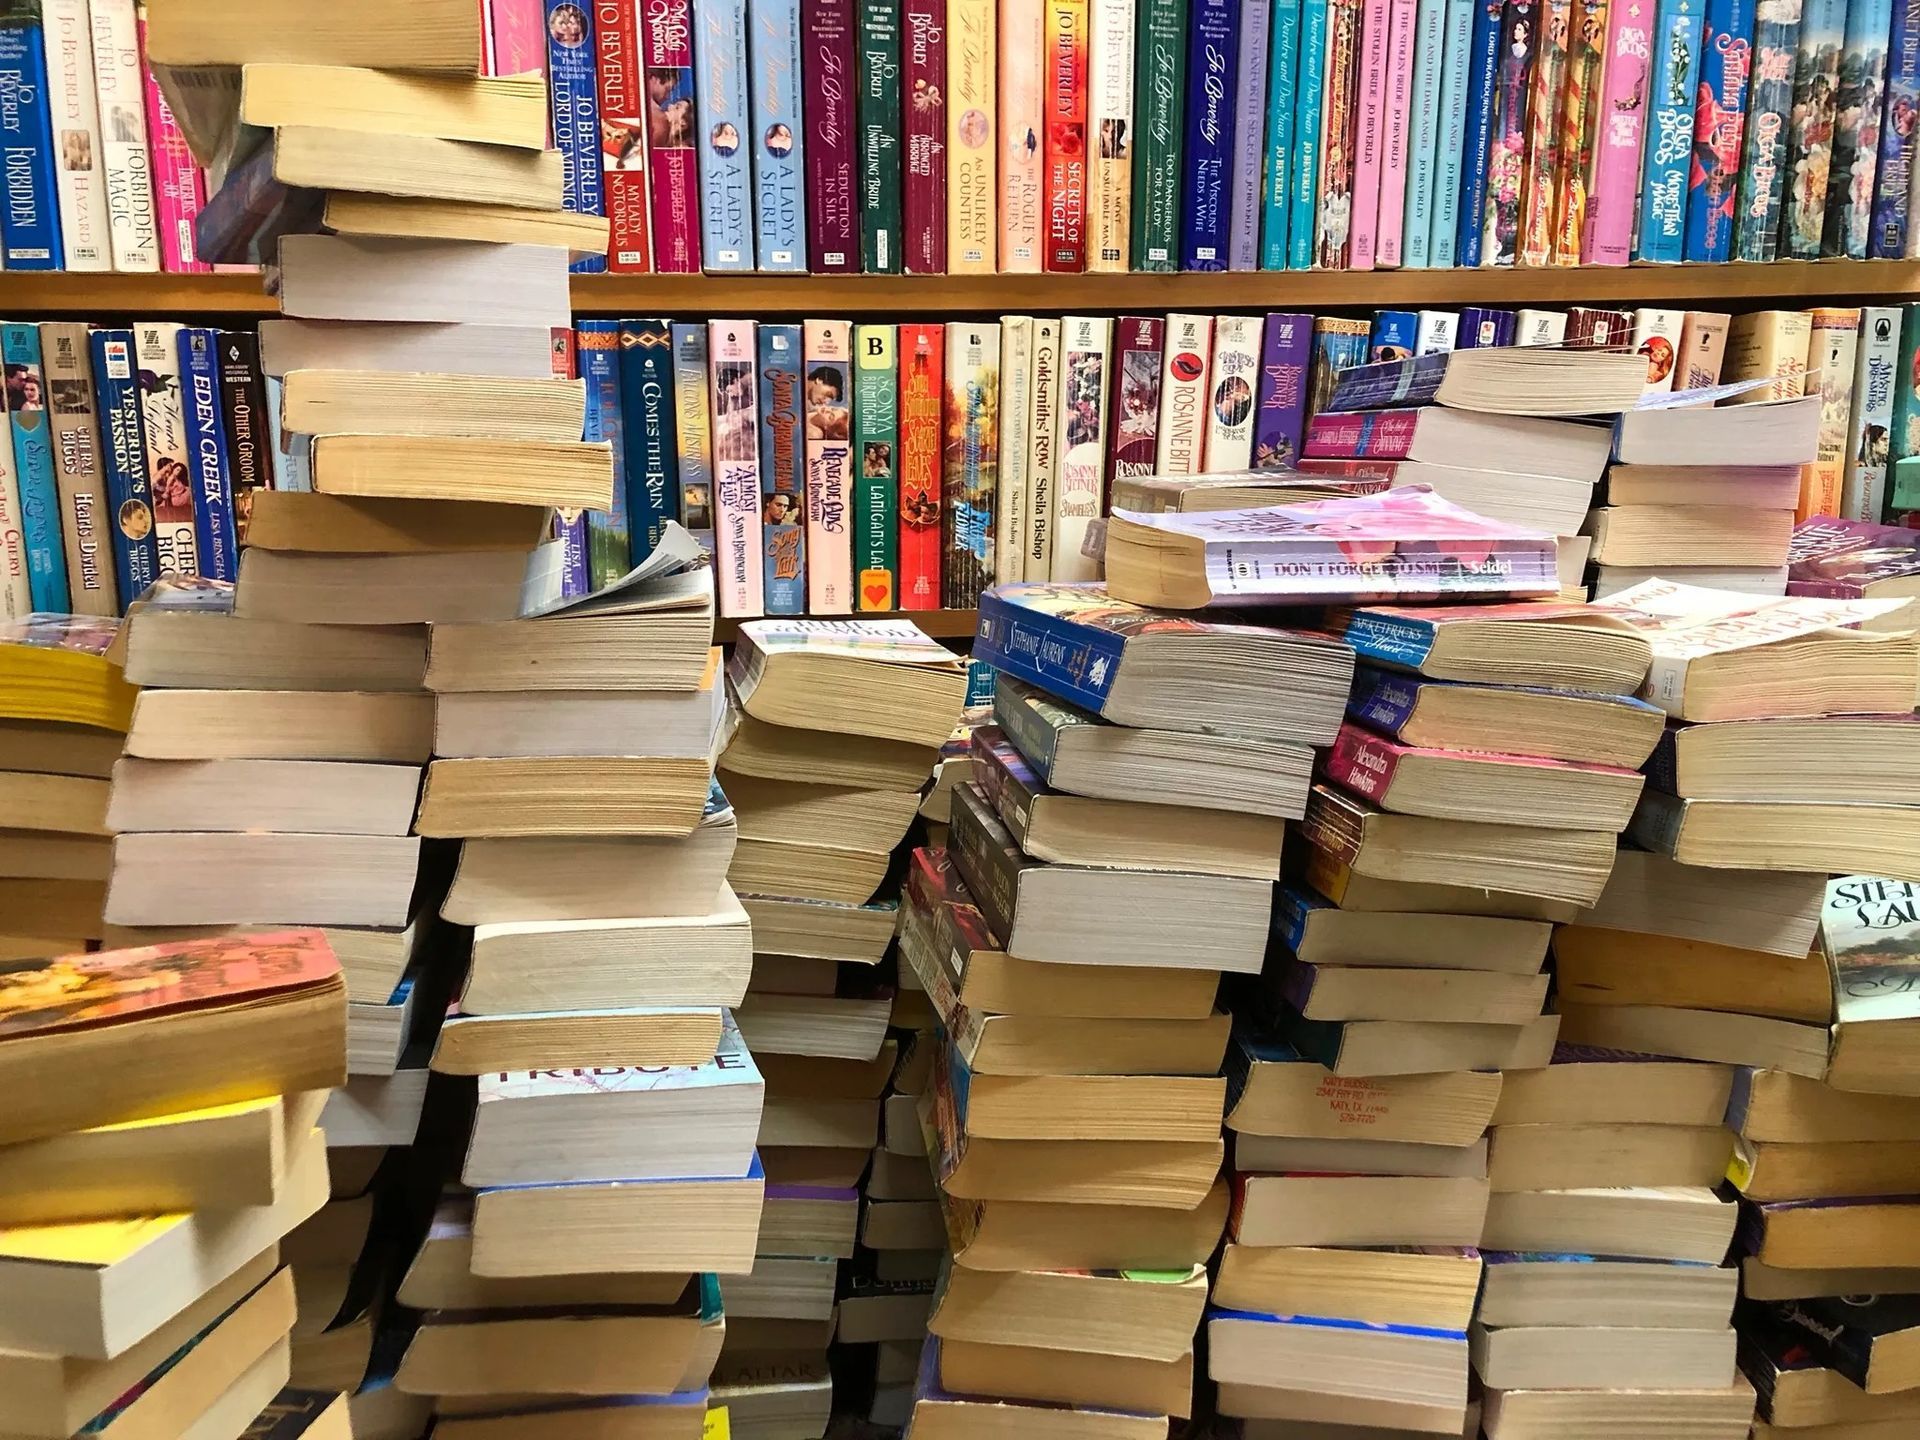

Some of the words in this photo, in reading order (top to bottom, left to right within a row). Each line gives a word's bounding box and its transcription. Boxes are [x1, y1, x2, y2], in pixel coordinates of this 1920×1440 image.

[598, 3, 618, 23] JO
[1056, 8, 1073, 28] JO
[1373, 5, 1383, 25] THE
[1458, 13, 1467, 43] EMILY
[1903, 0, 1919, 35] ANET
[94, 15, 117, 94] BEVERLEY
[119, 48, 136, 67] JO
[820, 46, 841, 73] Jo
[908, 13, 932, 68] BEVERLEY
[1155, 45, 1174, 74] Jo
[1206, 45, 1225, 74] Jo
[1281, 16, 1296, 61] Deirdre
[1371, 29, 1381, 64] STOLEN
[1457, 48, 1465, 68] AND
[1488, 31, 1496, 55] LORD
[62, 40, 81, 121] BEVERLEY
[601, 31, 624, 113] BEVERLEY
[866, 51, 886, 100] BEVERLEY
[883, 63, 897, 78] JO
[1059, 34, 1072, 117] BEVERLEY
[1107, 29, 1123, 114] BEVERLEY
[1279, 61, 1296, 82] and
[1455, 71, 1464, 91] THE
[1901, 37, 1917, 85] BIEBER
[0, 69, 21, 133] BEVERLEY
[18, 84, 35, 102] JO
[1279, 88, 1292, 107] Don
[1369, 69, 1380, 97] BRIDE
[1480, 57, 1495, 124] WRAYBOURNE'S
[576, 95, 592, 115] JO
[819, 76, 842, 149] Beverley
[1151, 76, 1173, 146] Beverley
[1200, 76, 1224, 146] Beverley
[1277, 108, 1291, 138] Juan
[1367, 102, 1376, 114] JO
[1452, 93, 1462, 119] DARK
[866, 124, 880, 175] UNWILLING
[909, 135, 921, 174] MARRIAGE
[920, 134, 932, 176] ARRANGED
[1276, 146, 1285, 157] JO
[1364, 117, 1375, 165] BEVERLEY
[1449, 122, 1458, 154] ANGEL
[1476, 125, 1486, 174] BETROTHED
[1655, 109, 1676, 165] BICOS
[1674, 114, 1693, 159] OLGA
[577, 121, 598, 216] BEVERLEY
[779, 165, 794, 177] A
[825, 178, 836, 194] IN
[976, 158, 985, 171] AN
[1053, 165, 1063, 185] THE
[1165, 154, 1175, 176] TOO
[1210, 158, 1221, 176] THE
[1274, 159, 1285, 208] BEVERLEY
[1447, 161, 1455, 173] JO
[5, 147, 37, 226] FORBIDDEN
[108, 167, 131, 229] MAGIC
[128, 147, 153, 248] FORBIDDEN
[628, 186, 639, 203] MY
[761, 171, 776, 239] SECRET
[838, 163, 850, 238] SEDUCTION
[867, 178, 880, 209] BRIDE
[960, 163, 971, 240] COUNTESS
[1007, 175, 1020, 232] RETURN
[1066, 162, 1080, 226] SECRETS
[1208, 181, 1220, 235] VISCOUNT
[1444, 176, 1454, 222] BEVERLEY
[1651, 181, 1664, 219] MAGIC
[1663, 170, 1683, 205] MORE
[74, 177, 90, 243] HAZARD
[612, 173, 628, 246] NOTORIOUS
[629, 204, 641, 235] LADY
[780, 186, 796, 246] LADY'S
[825, 198, 837, 225] SILK
[975, 174, 986, 246] UNLIKELY
[1052, 190, 1066, 241] NIGHT
[1163, 180, 1175, 242] DANGEROUS
[1471, 189, 1480, 228] BEVERLEY
[1663, 205, 1680, 236] THAN
[1068, 229, 1078, 244] OF
[868, 337, 885, 355] B
[193, 374, 216, 432] EDEN
[234, 387, 245, 403] THE
[679, 368, 703, 420] FALCON'S
[862, 376, 877, 434] BIRMINGHAM
[877, 376, 893, 433] SONYA
[1036, 346, 1052, 433] Goldsmiths'
[1262, 364, 1290, 409] BITTNER
[1286, 365, 1302, 408] ROSANNE
[1866, 357, 1882, 412] DREAMERS
[1878, 362, 1893, 407] MYSTIC
[142, 399, 162, 453] Defiant
[162, 397, 179, 451] Hearts
[234, 404, 252, 439] OTHER
[642, 382, 662, 436] COMES
[1172, 386, 1196, 445] ROSANNE
[61, 430, 78, 475] BIGGS
[78, 425, 96, 476] CHERYL
[110, 408, 130, 472] PASSION
[121, 386, 146, 493] YESTERDAY'S
[647, 438, 661, 471] THE
[683, 424, 707, 477] MISTRESS
[1036, 435, 1050, 468] Row
[201, 438, 222, 505] CREEK
[238, 442, 255, 481] GROOM
[822, 447, 848, 499] RENEGADE
[1171, 449, 1191, 474] BITT
[646, 471, 666, 508] RAIN
[736, 464, 758, 513] ALMOST
[809, 482, 822, 521] BIRMINGHAM
[1035, 477, 1047, 514] Sheila
[74, 492, 95, 536] Hearts
[211, 511, 221, 535] LISA
[870, 485, 884, 546] LANIGAN'S
[214, 538, 226, 579] BINGHA
[560, 528, 573, 582] BINGHAM
[571, 544, 581, 567] LISA
[871, 549, 885, 570] LAD
[1033, 518, 1046, 559] Bishop
[80, 540, 100, 589] Divided
[130, 549, 141, 581] BIGGS
[140, 544, 151, 587] CHERYL
[1274, 562, 1326, 577] DON'T
[1471, 559, 1512, 575] Seidel
[1005, 622, 1037, 654] STEPHANIE
[1035, 630, 1065, 673] LAURENS
[1347, 766, 1378, 794] Hawkins
[1354, 744, 1389, 775] Alexandra
[738, 1364, 813, 1380] ALTAR
